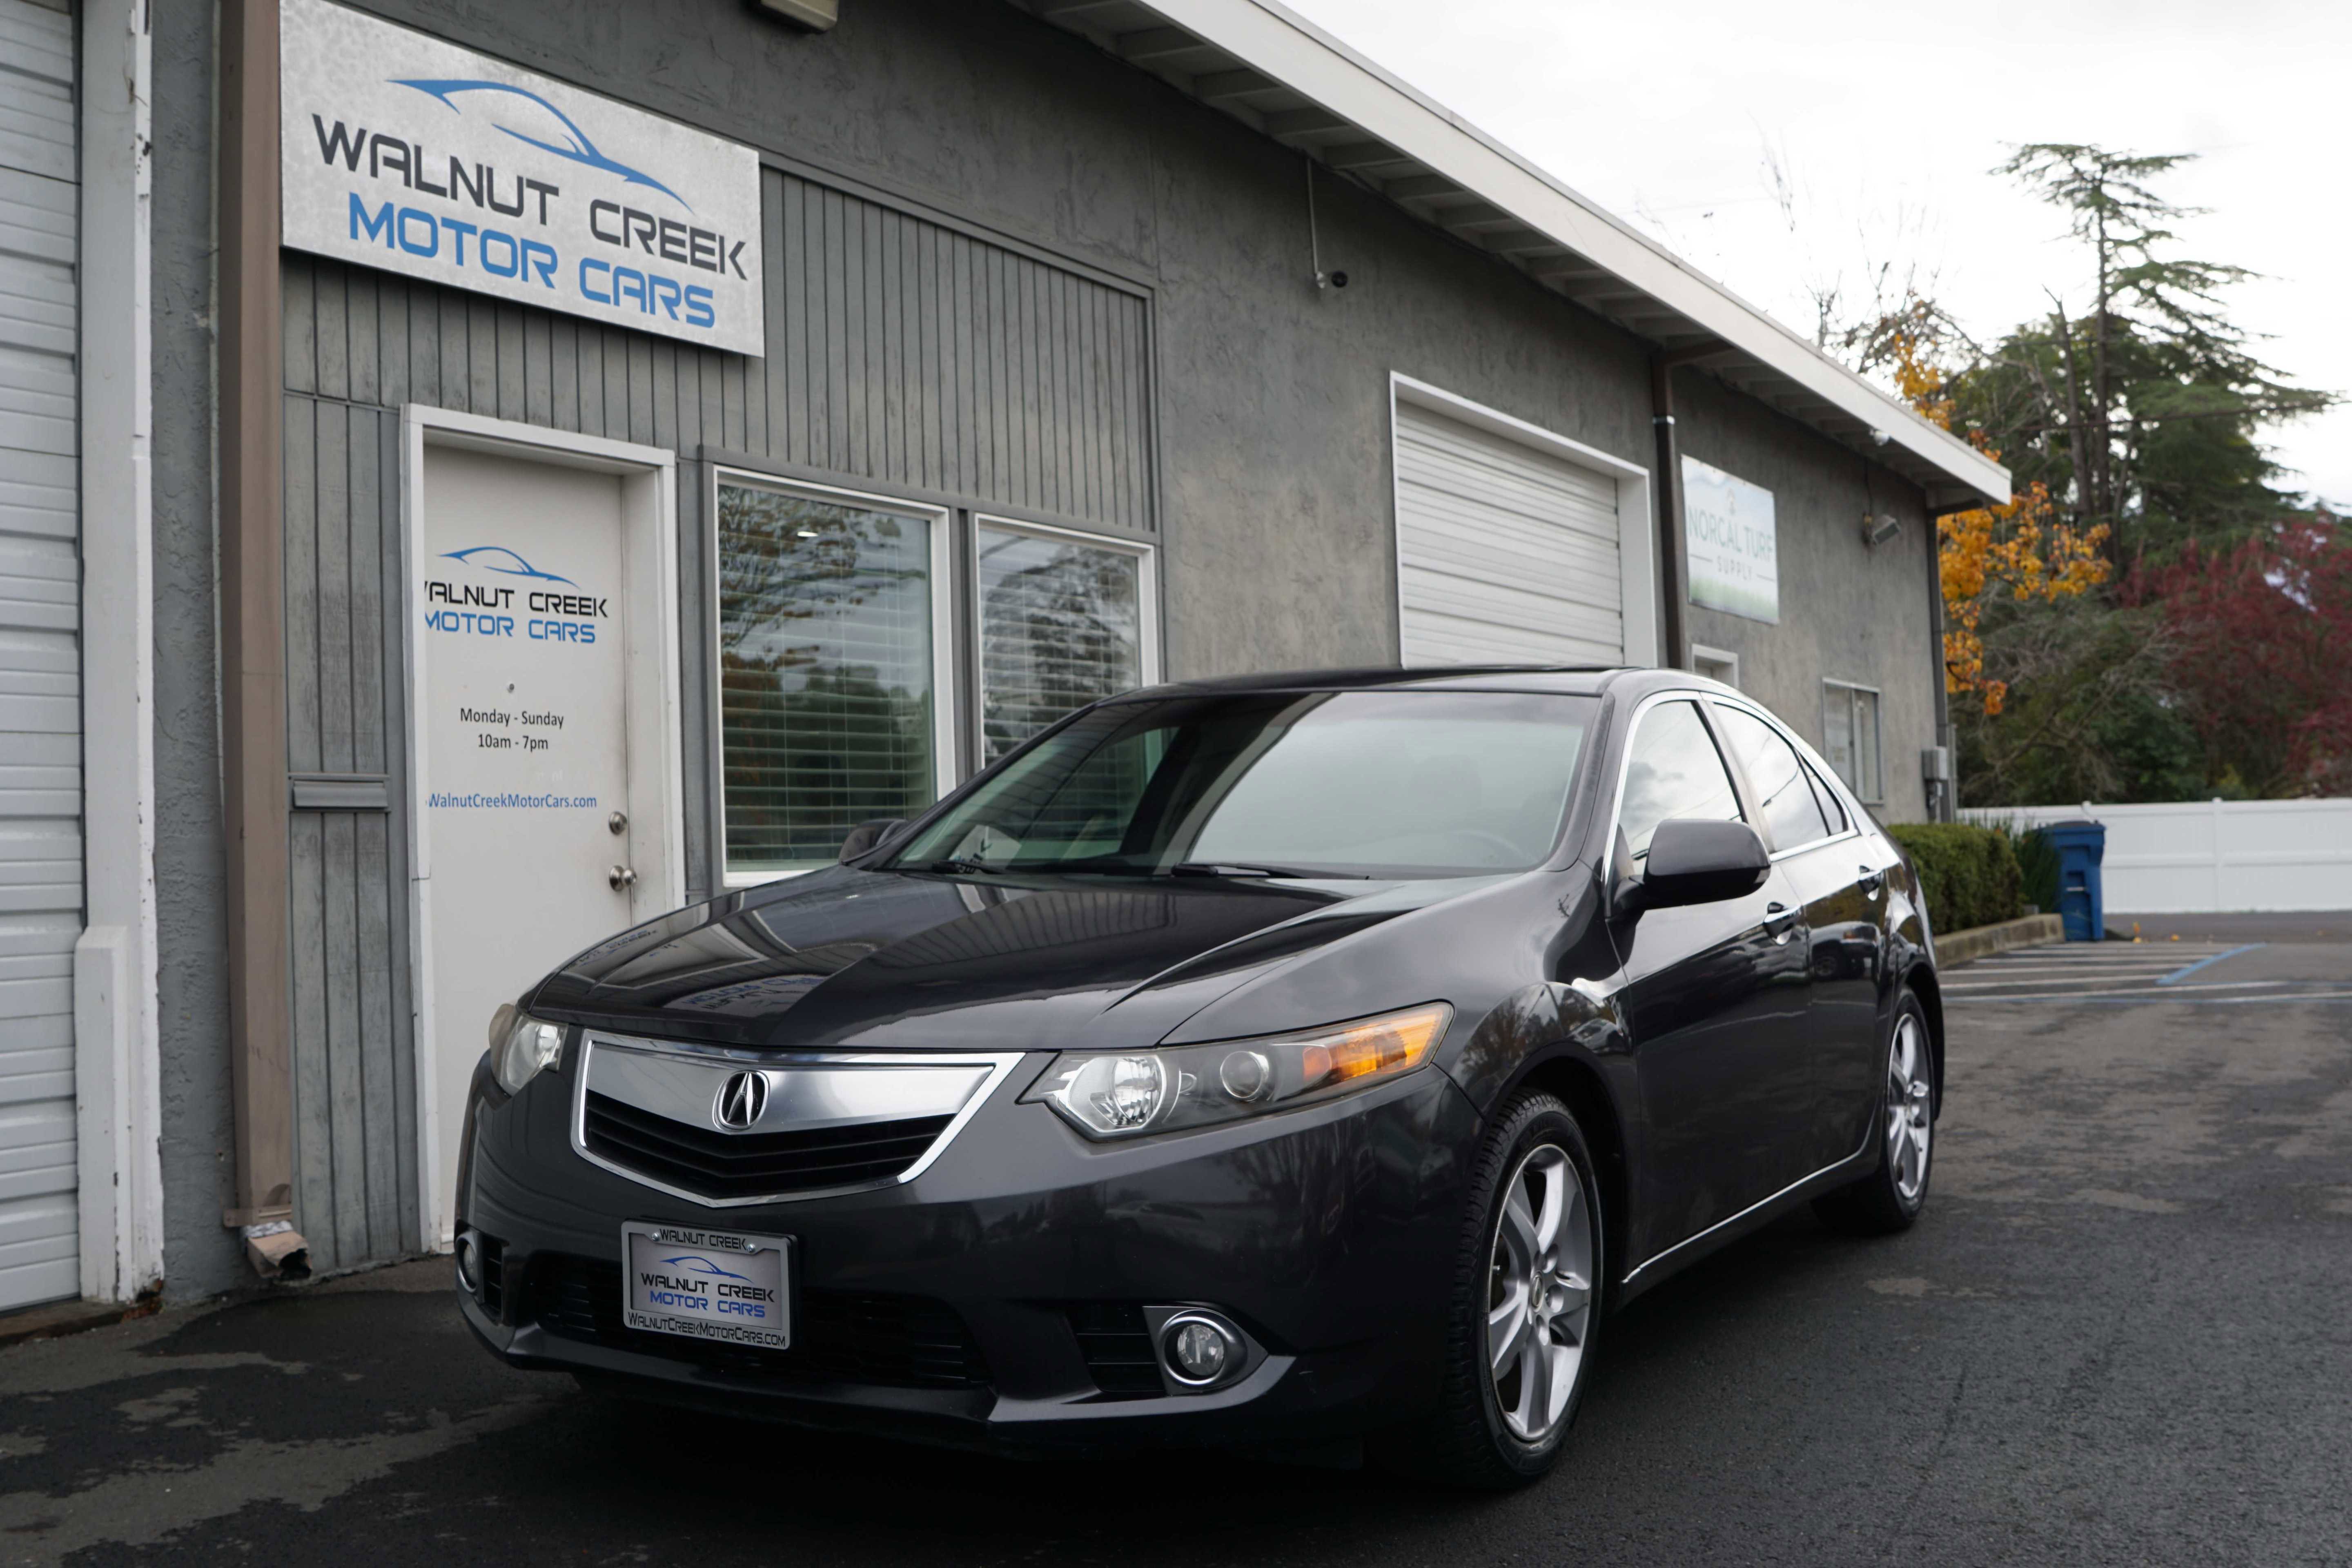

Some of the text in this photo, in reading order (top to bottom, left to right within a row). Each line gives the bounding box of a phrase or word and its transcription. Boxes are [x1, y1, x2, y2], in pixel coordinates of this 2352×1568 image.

[312, 113, 748, 280] WALNUT CREEK
[349, 192, 715, 328] MOTOR CARS
[1688, 506, 1773, 562] NORCAL TURF
[1717, 555, 1753, 580] SUPPLY
[529, 592, 608, 618] CREEK
[425, 610, 595, 644] MOTOR CARS
[461, 708, 510, 727] Monday
[522, 711, 564, 729] Sunday
[479, 734, 511, 748] 10am
[523, 735, 548, 752] 7pm
[429, 793, 597, 808] WalnutCreekMotorCars.com
[659, 1229, 746, 1251] WALNUT CREEK
[641, 1272, 775, 1302] WALNUT CREEK
[650, 1291, 766, 1318] MOTOR CARS
